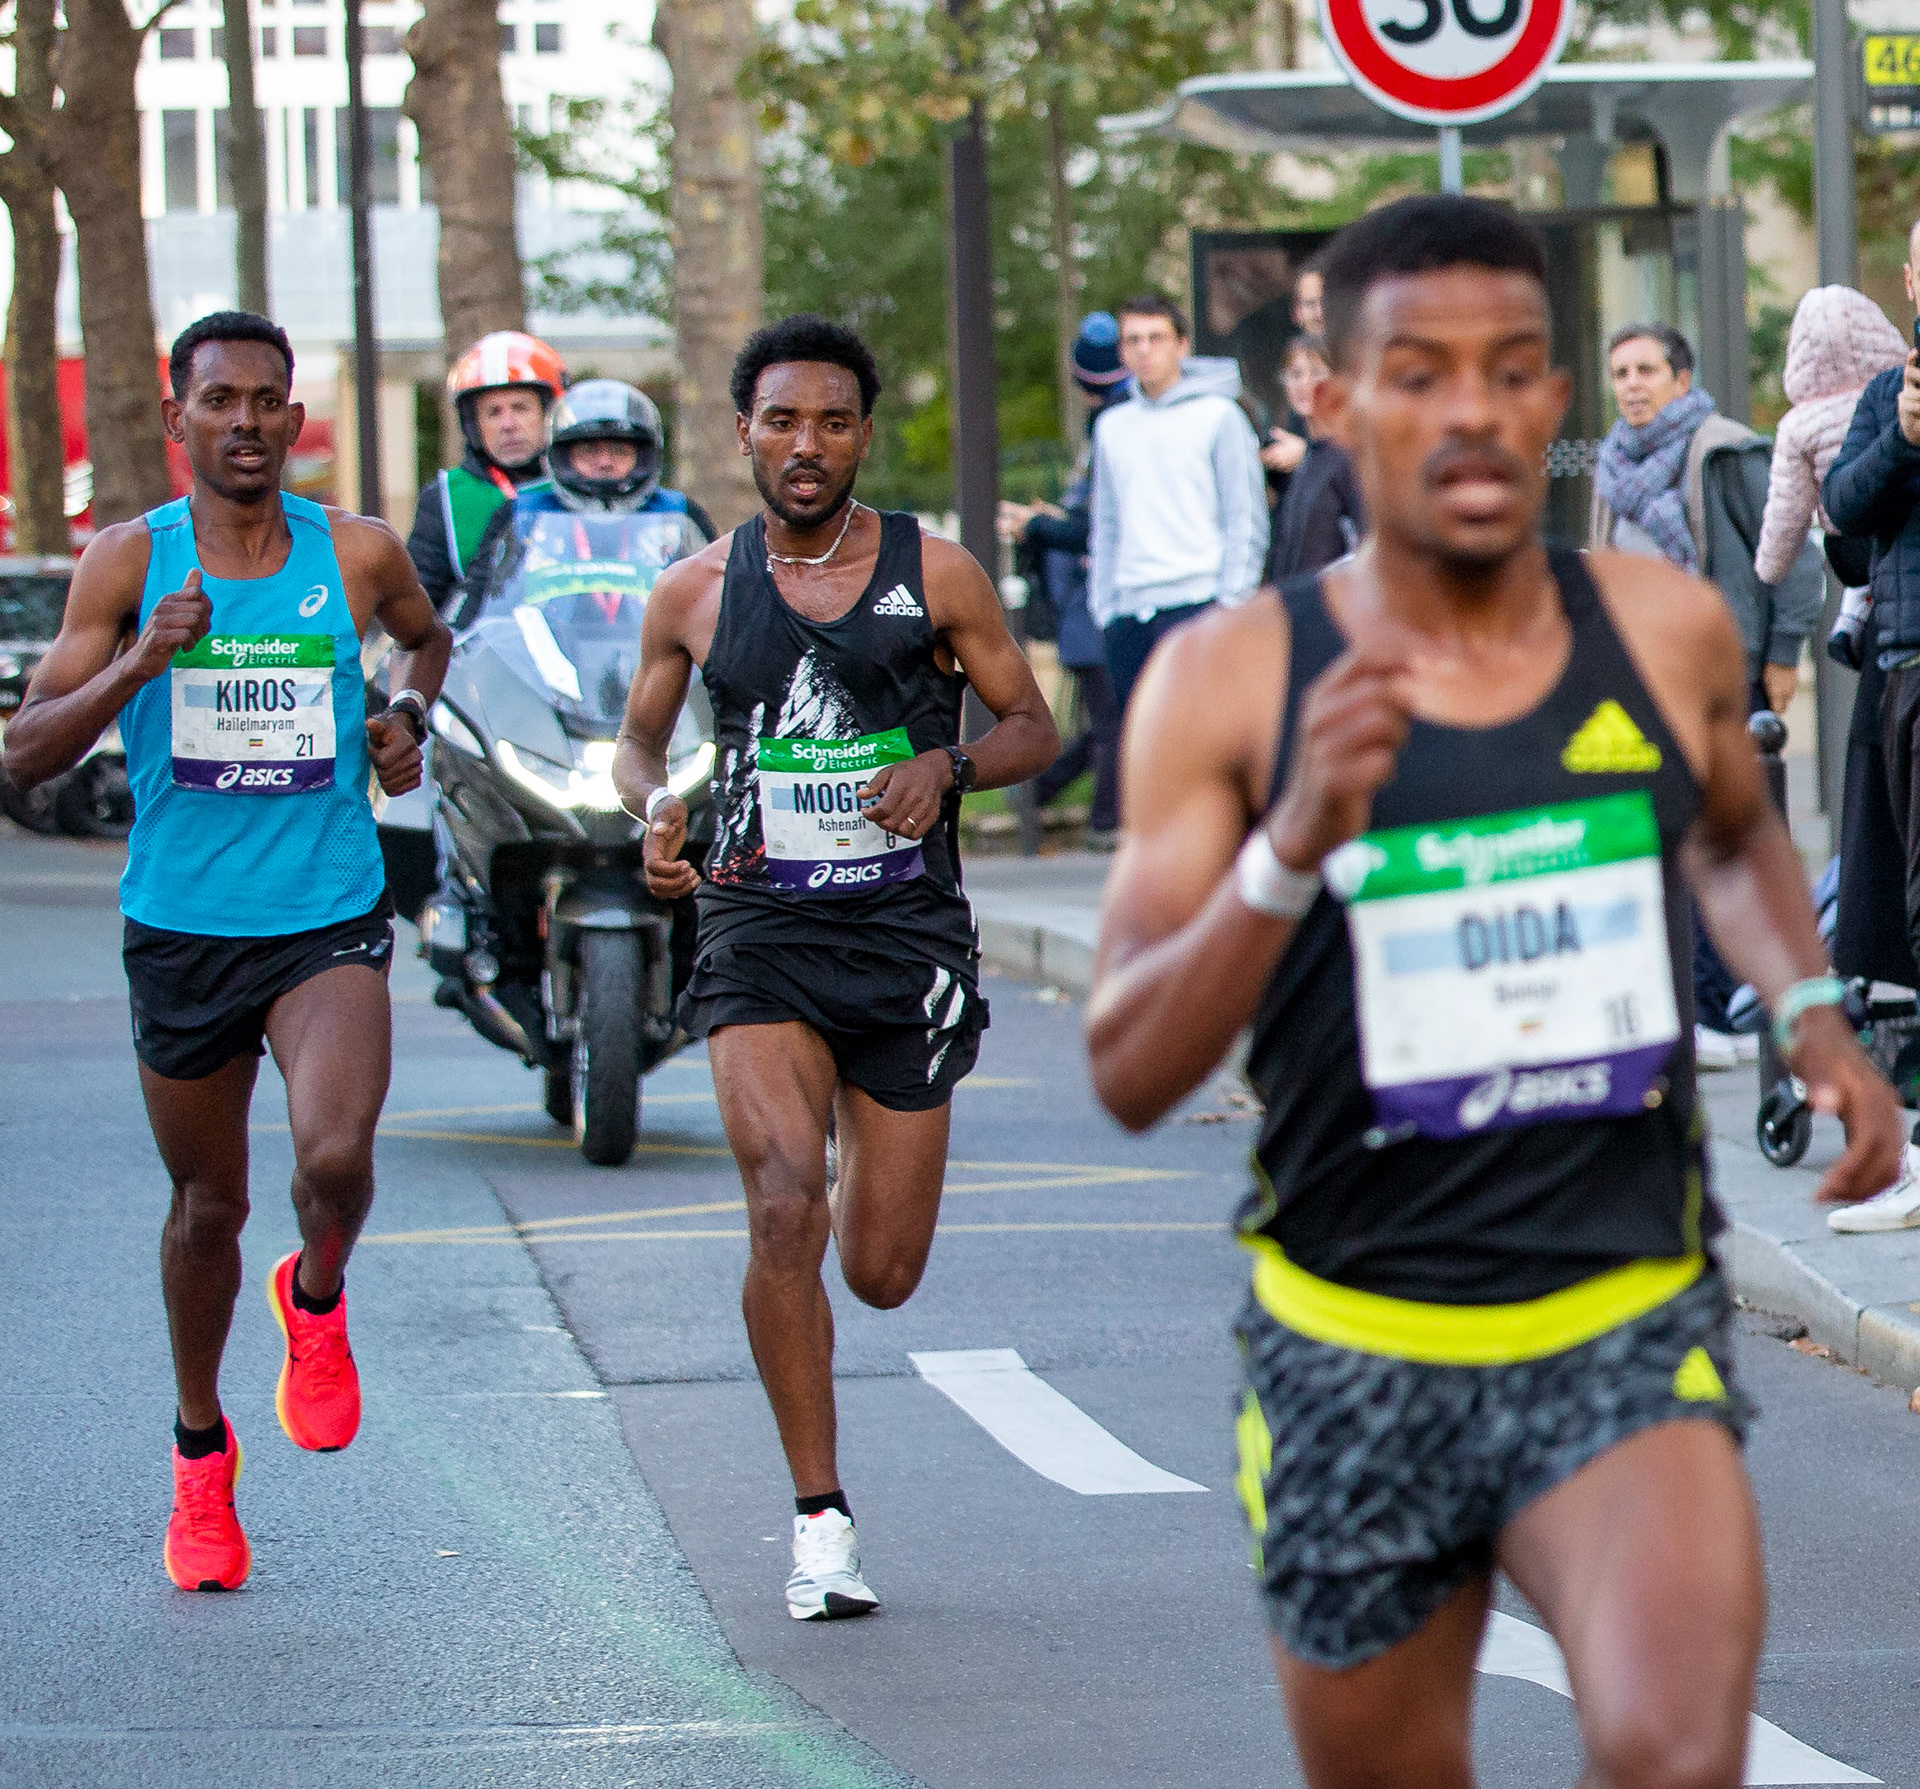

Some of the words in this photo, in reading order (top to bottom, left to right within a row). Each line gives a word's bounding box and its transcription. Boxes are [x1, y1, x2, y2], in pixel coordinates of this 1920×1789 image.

[873, 602, 924, 617] adidas
[211, 638, 299, 655] Schneider
[249, 656, 299, 665] Electric
[216, 678, 296, 712] KIROS
[217, 717, 295, 733] Hailelmaryam
[296, 733, 314, 757] 21
[792, 742, 878, 760] Schneider
[829, 756, 878, 769] Electric
[794, 780, 884, 814] MOGE
[818, 817, 866, 832] Ashenafi
